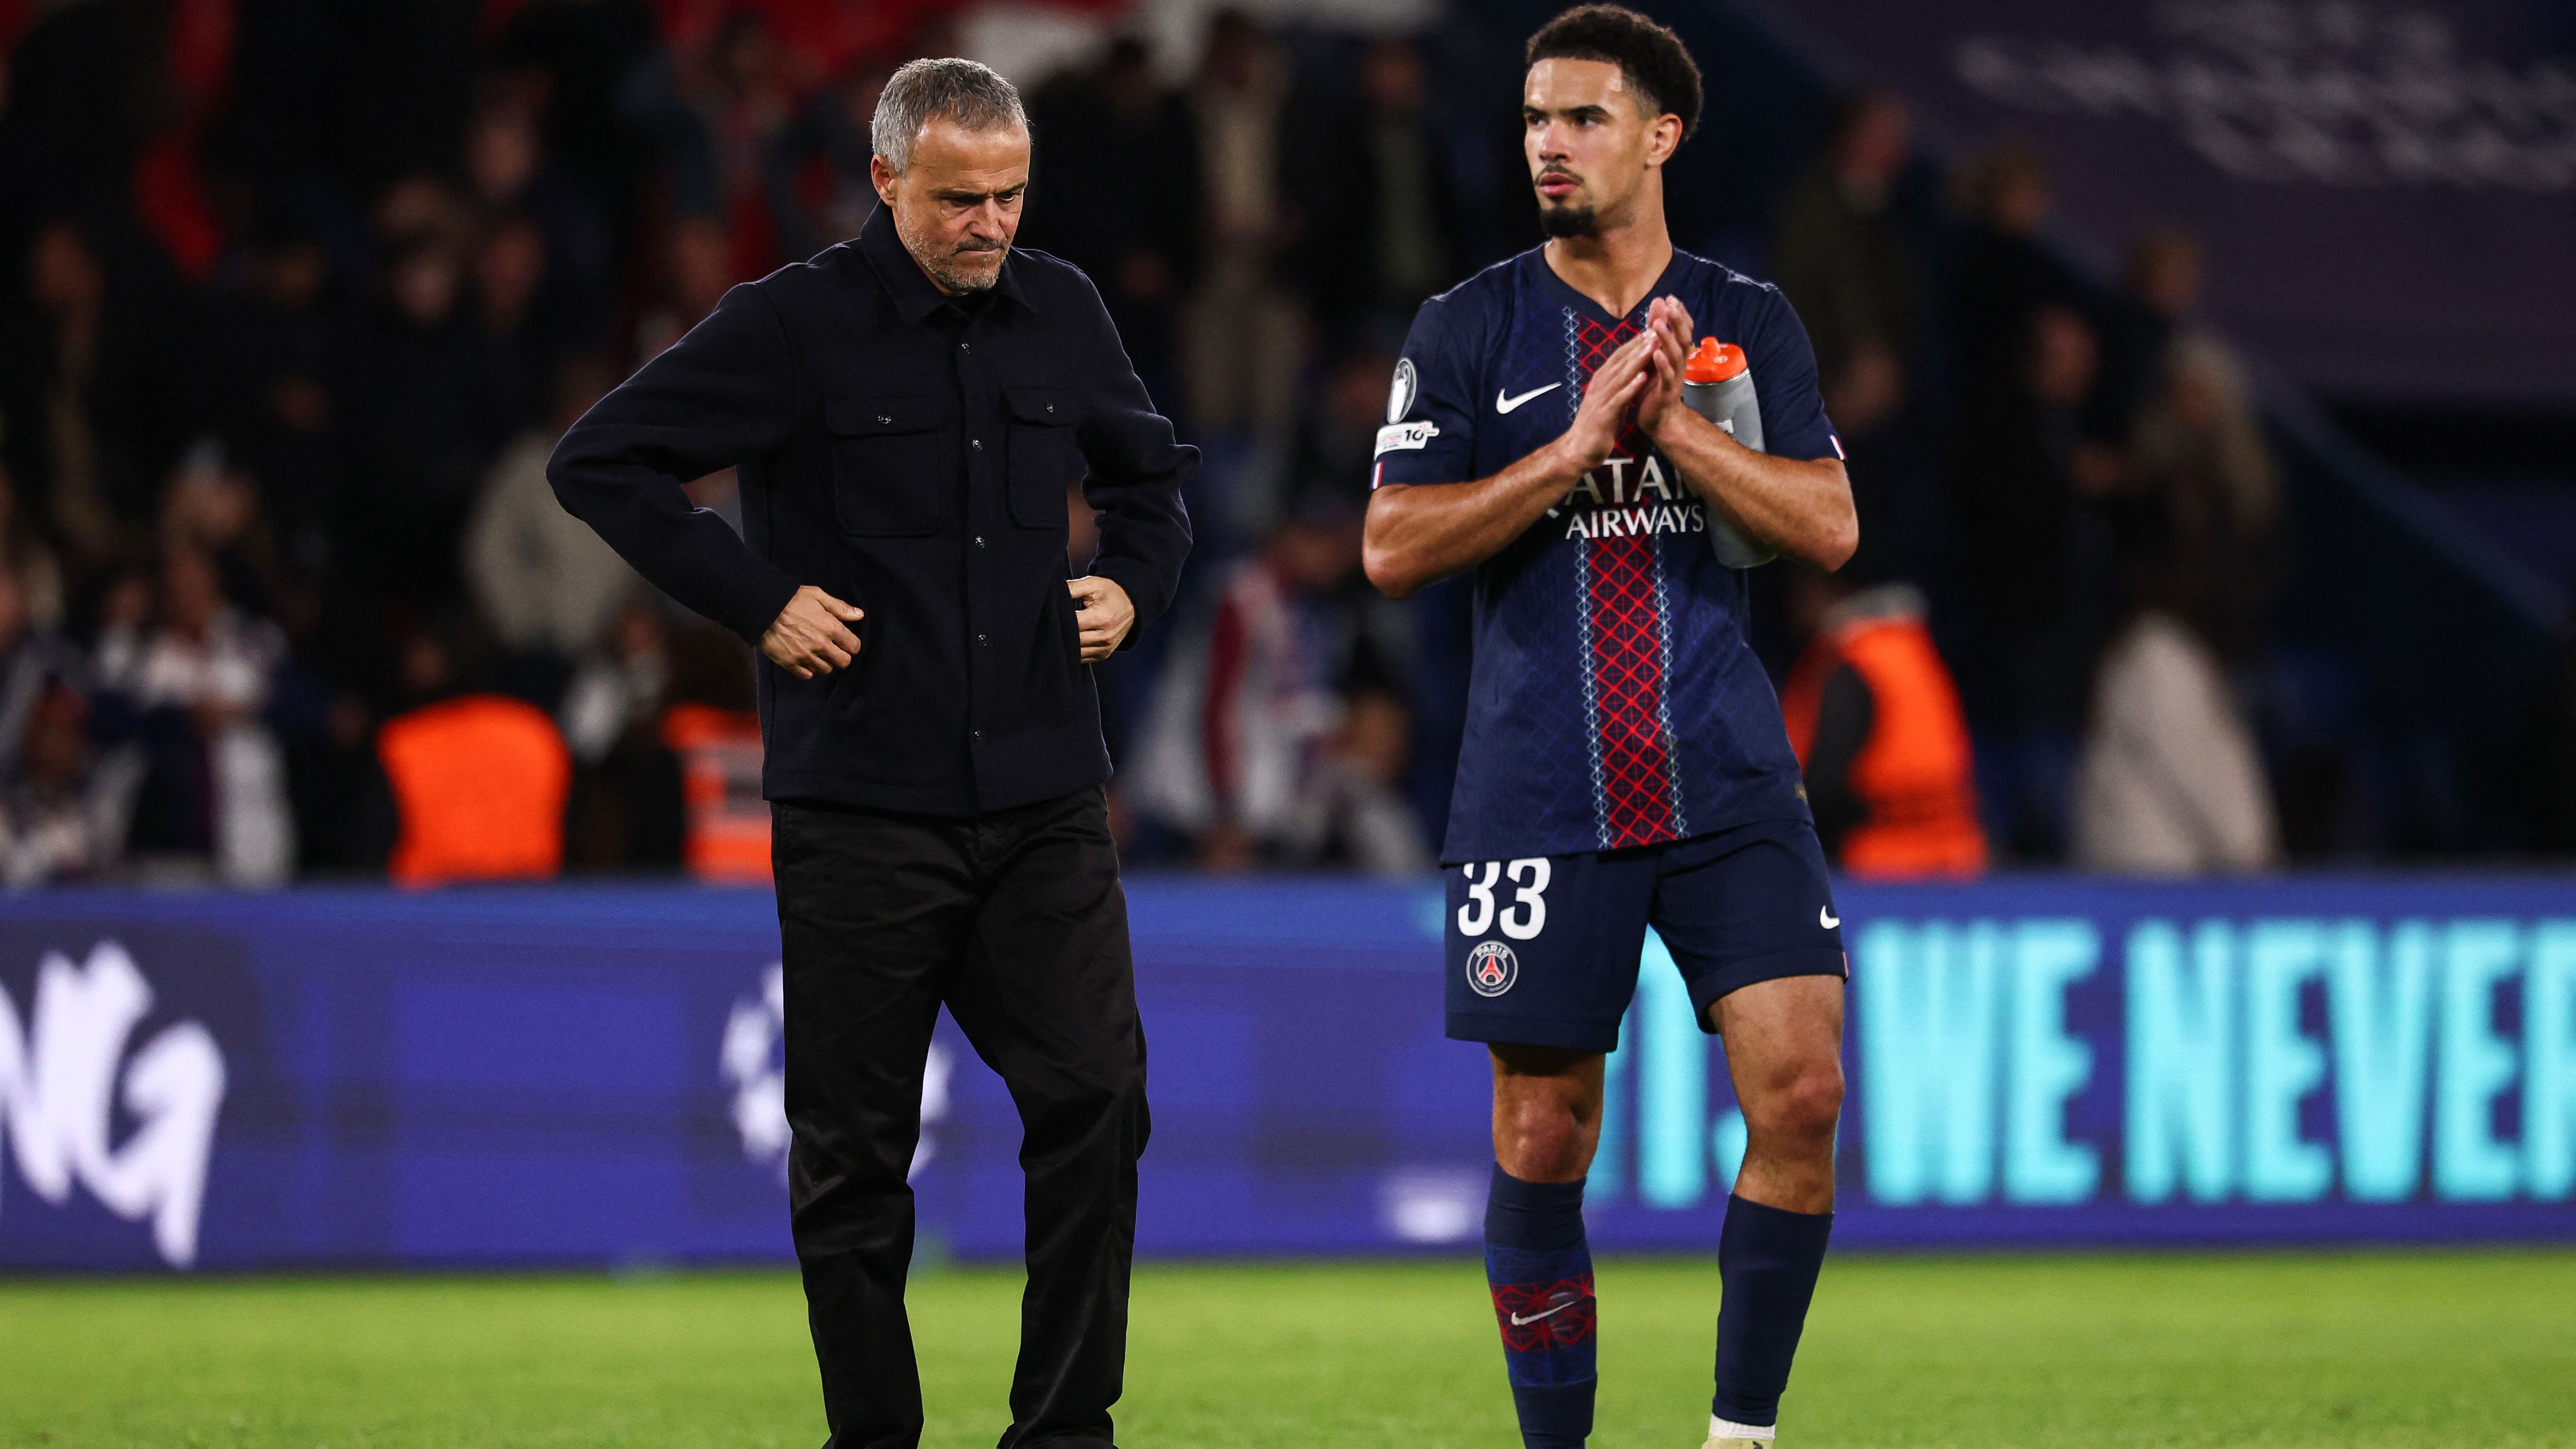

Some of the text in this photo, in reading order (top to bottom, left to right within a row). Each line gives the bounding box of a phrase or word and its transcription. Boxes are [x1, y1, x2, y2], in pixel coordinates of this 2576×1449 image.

[1546, 456, 1684, 519] ATA
[1565, 504, 1704, 540] AIRWAYS
[1458, 857, 1551, 940] 33
[1475, 944, 1509, 959] PARIS
[1858, 921, 2099, 1206] WE
